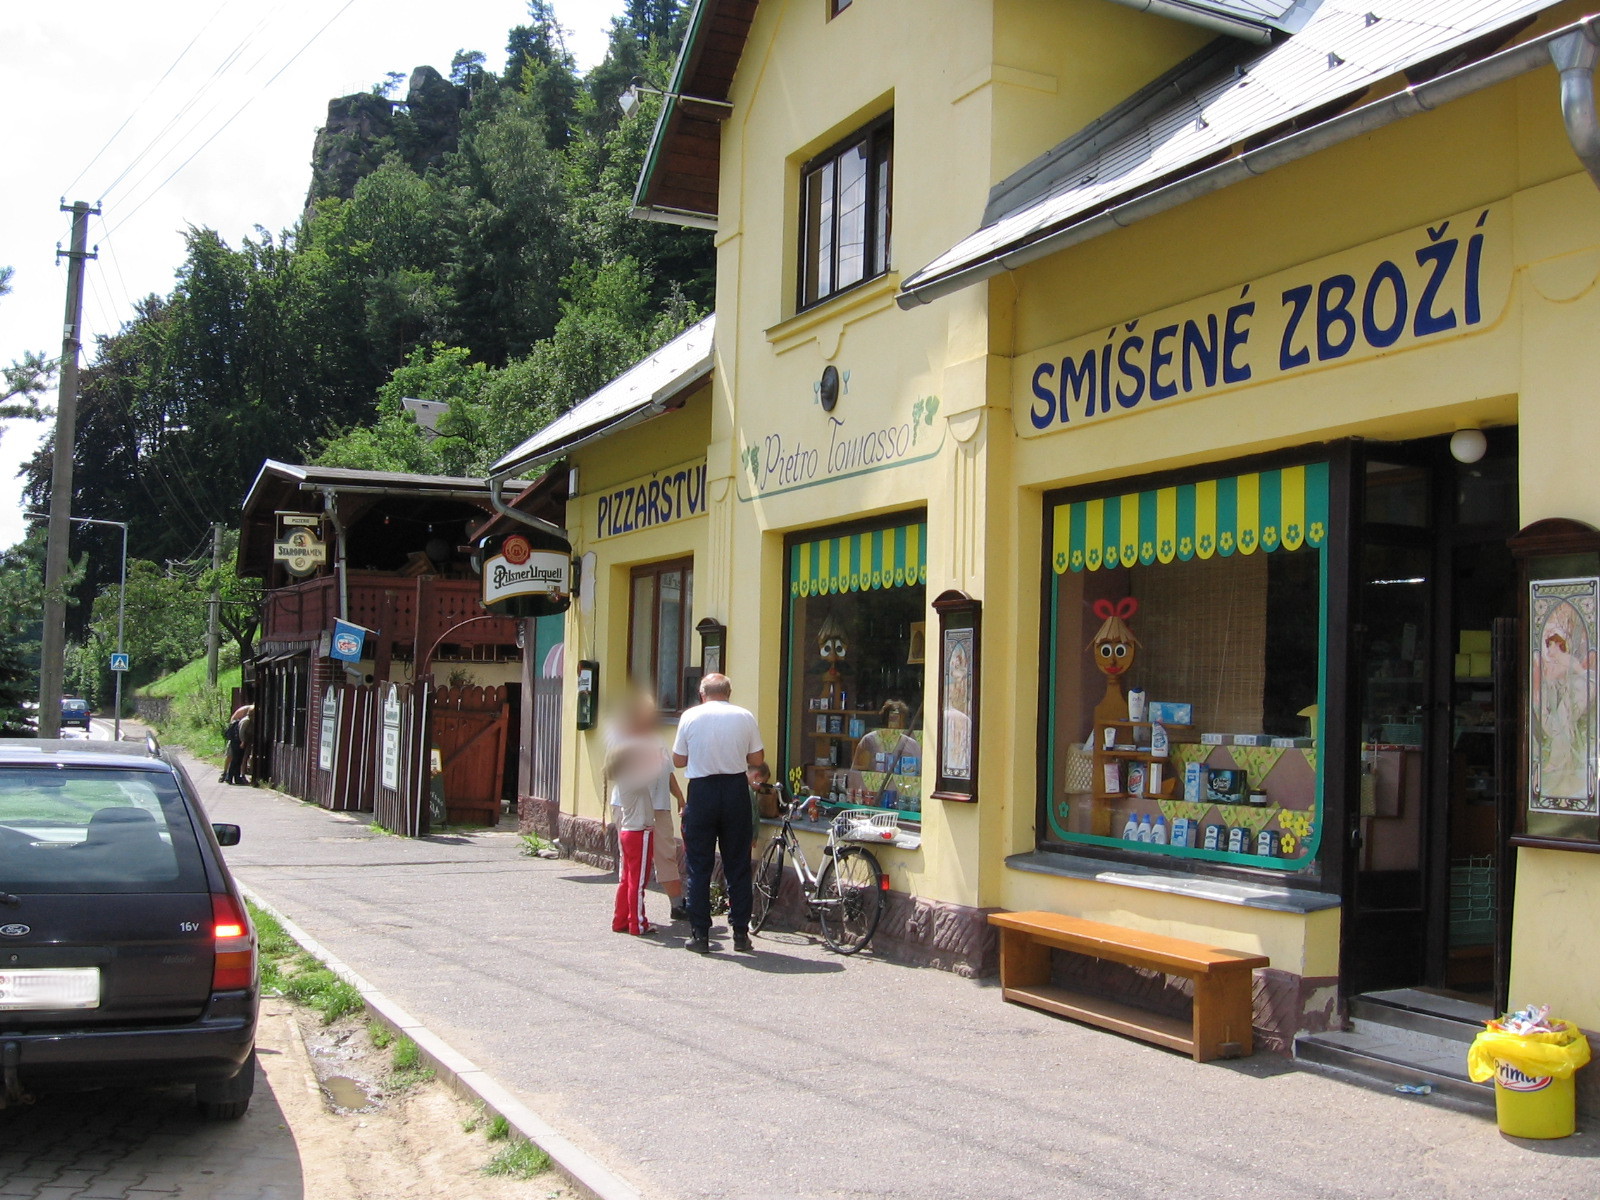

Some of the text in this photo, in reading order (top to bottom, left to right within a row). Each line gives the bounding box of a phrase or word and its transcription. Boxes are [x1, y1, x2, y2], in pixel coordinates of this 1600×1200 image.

[1030, 209, 1489, 430] SMÍŠENÉ ZBOŽÍ
[760, 416, 910, 490] Pietro Tomasso
[597, 457, 708, 539] PIZZAŘSTVÍ
[278, 546, 322, 557] STAROPRAMEN
[493, 564, 562, 590] Pilsner Urquell
